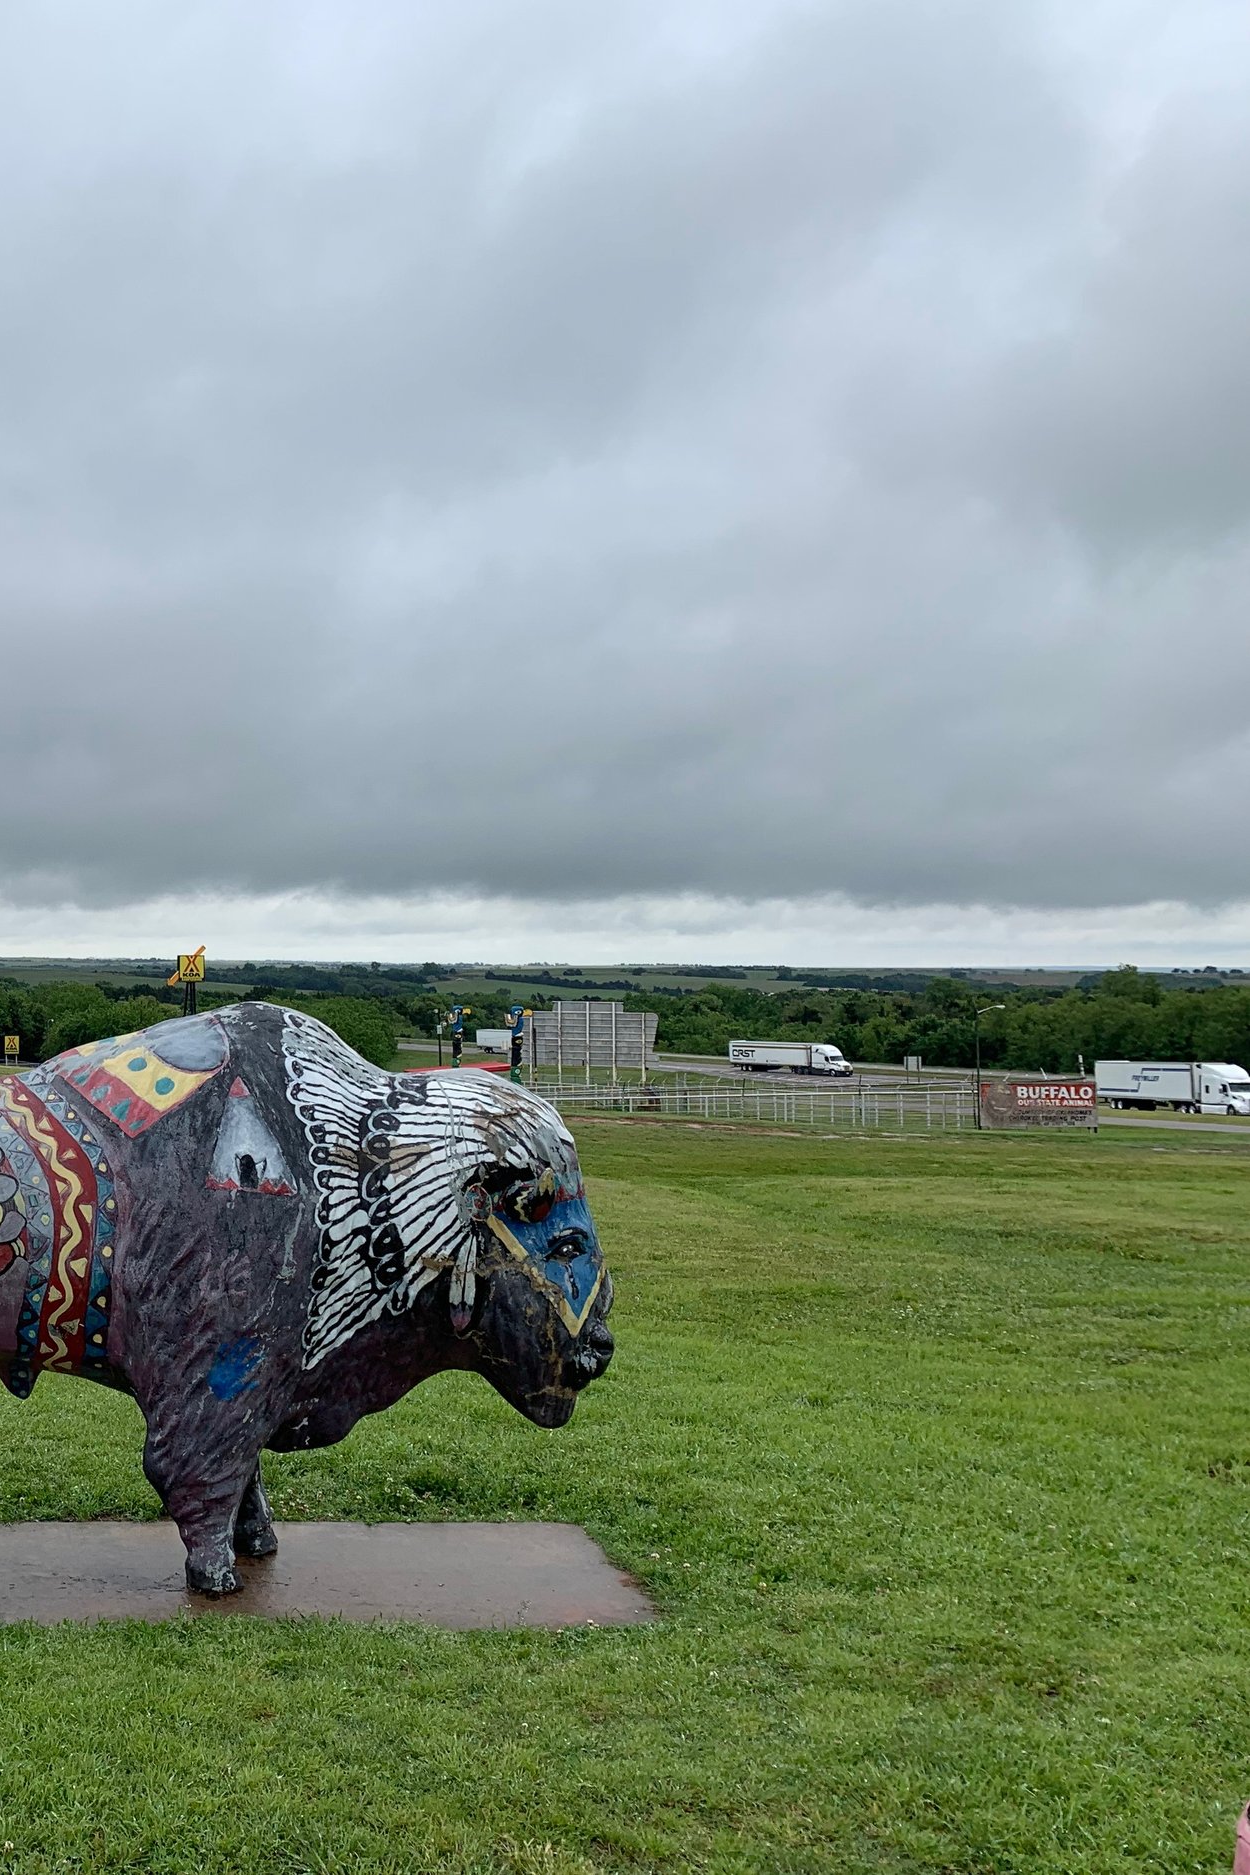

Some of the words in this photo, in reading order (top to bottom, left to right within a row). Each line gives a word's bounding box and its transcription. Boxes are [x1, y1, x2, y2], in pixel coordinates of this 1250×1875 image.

[732, 1049, 755, 1057] CRST
[1016, 1086, 1093, 1099] BUFFALO
[1037, 1099, 1061, 1107] STATE
